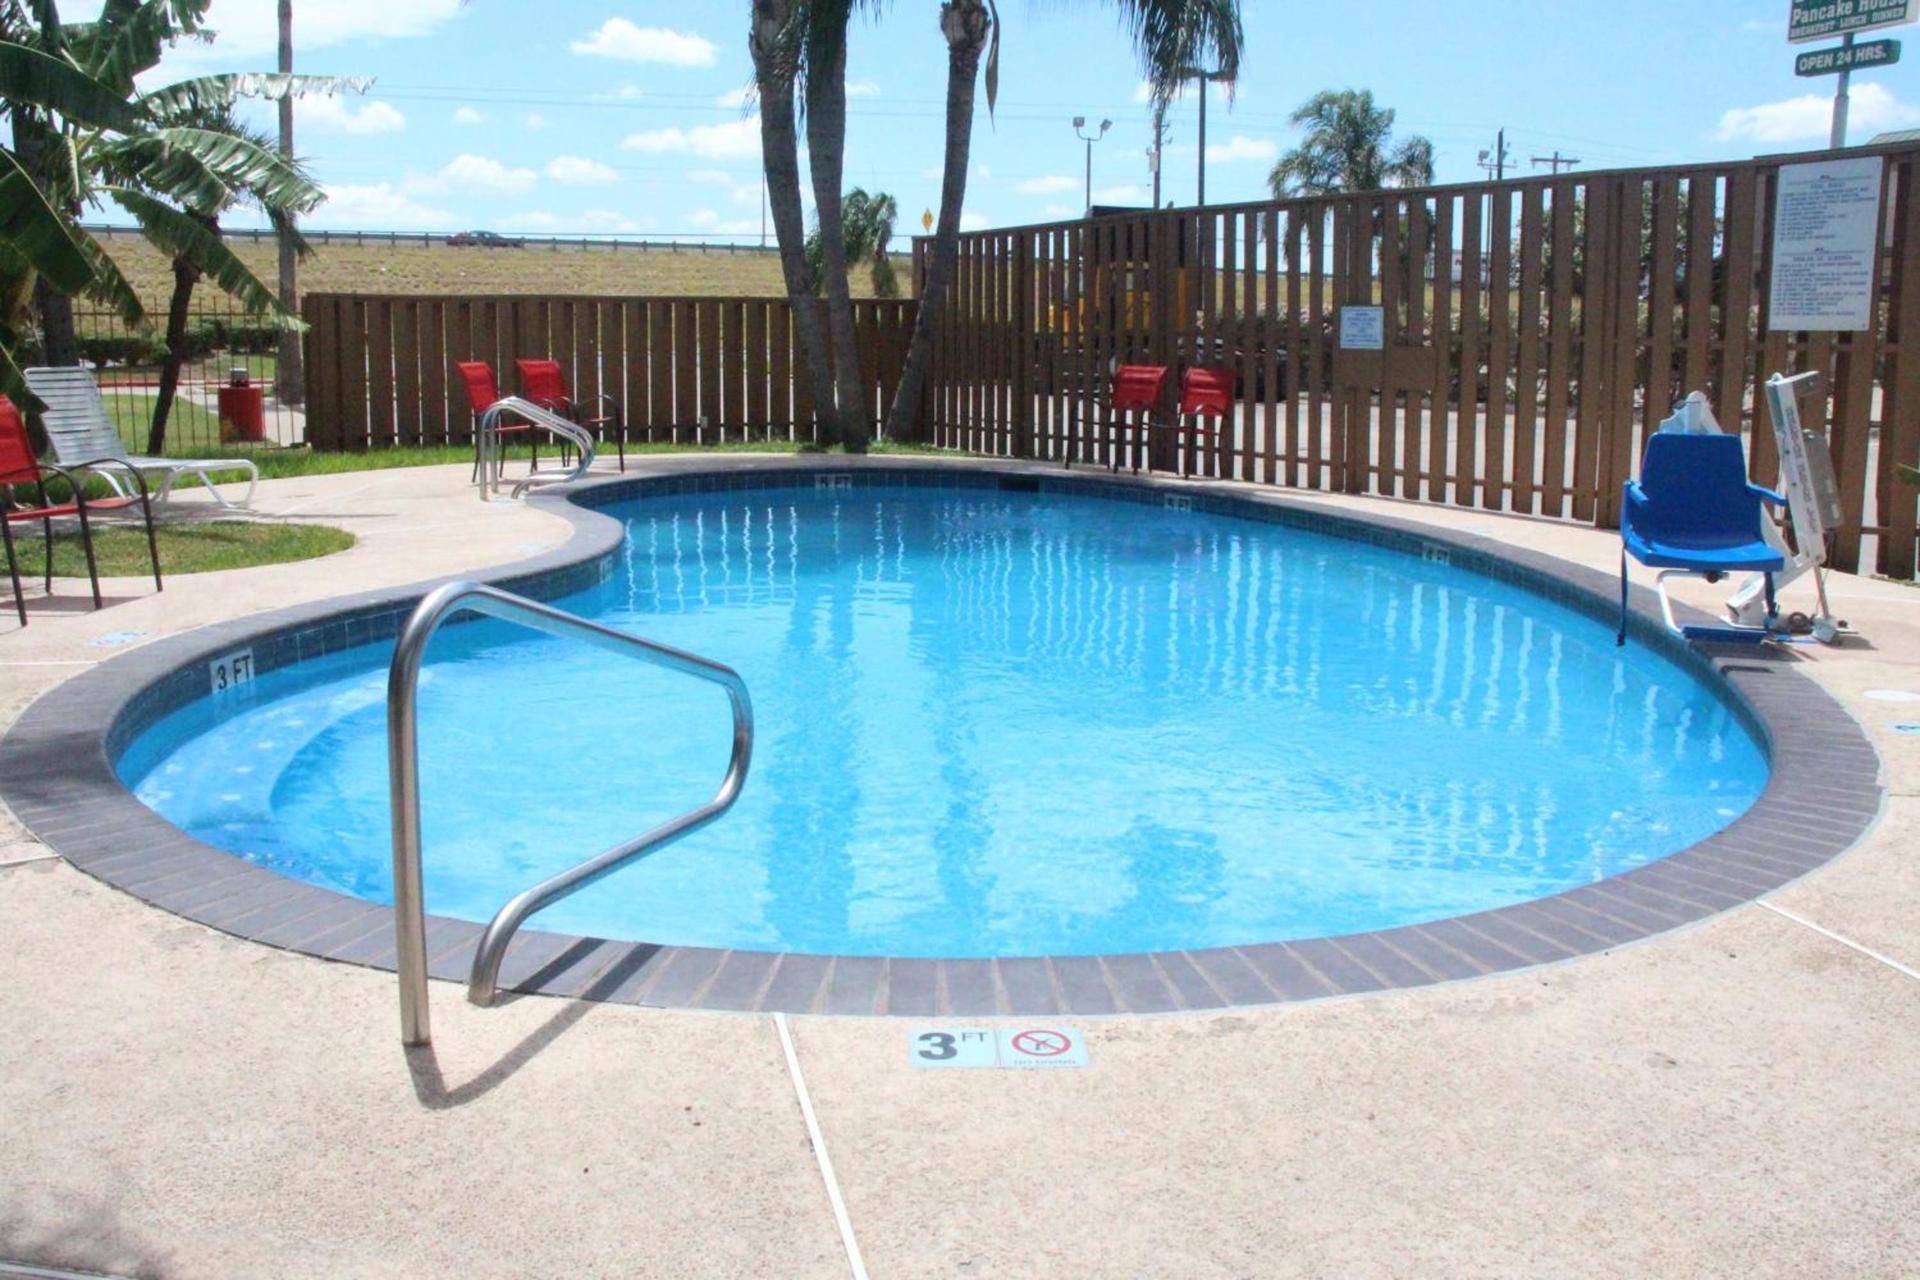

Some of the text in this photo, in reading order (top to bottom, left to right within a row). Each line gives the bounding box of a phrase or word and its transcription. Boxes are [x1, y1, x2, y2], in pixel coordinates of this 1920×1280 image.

[1791, 0, 1905, 26] Pancake Hou
[1800, 45, 1887, 71] OPEN 24 HRS.
[217, 654, 251, 690] 3 FT
[918, 1032, 987, 1061] 3 FT
